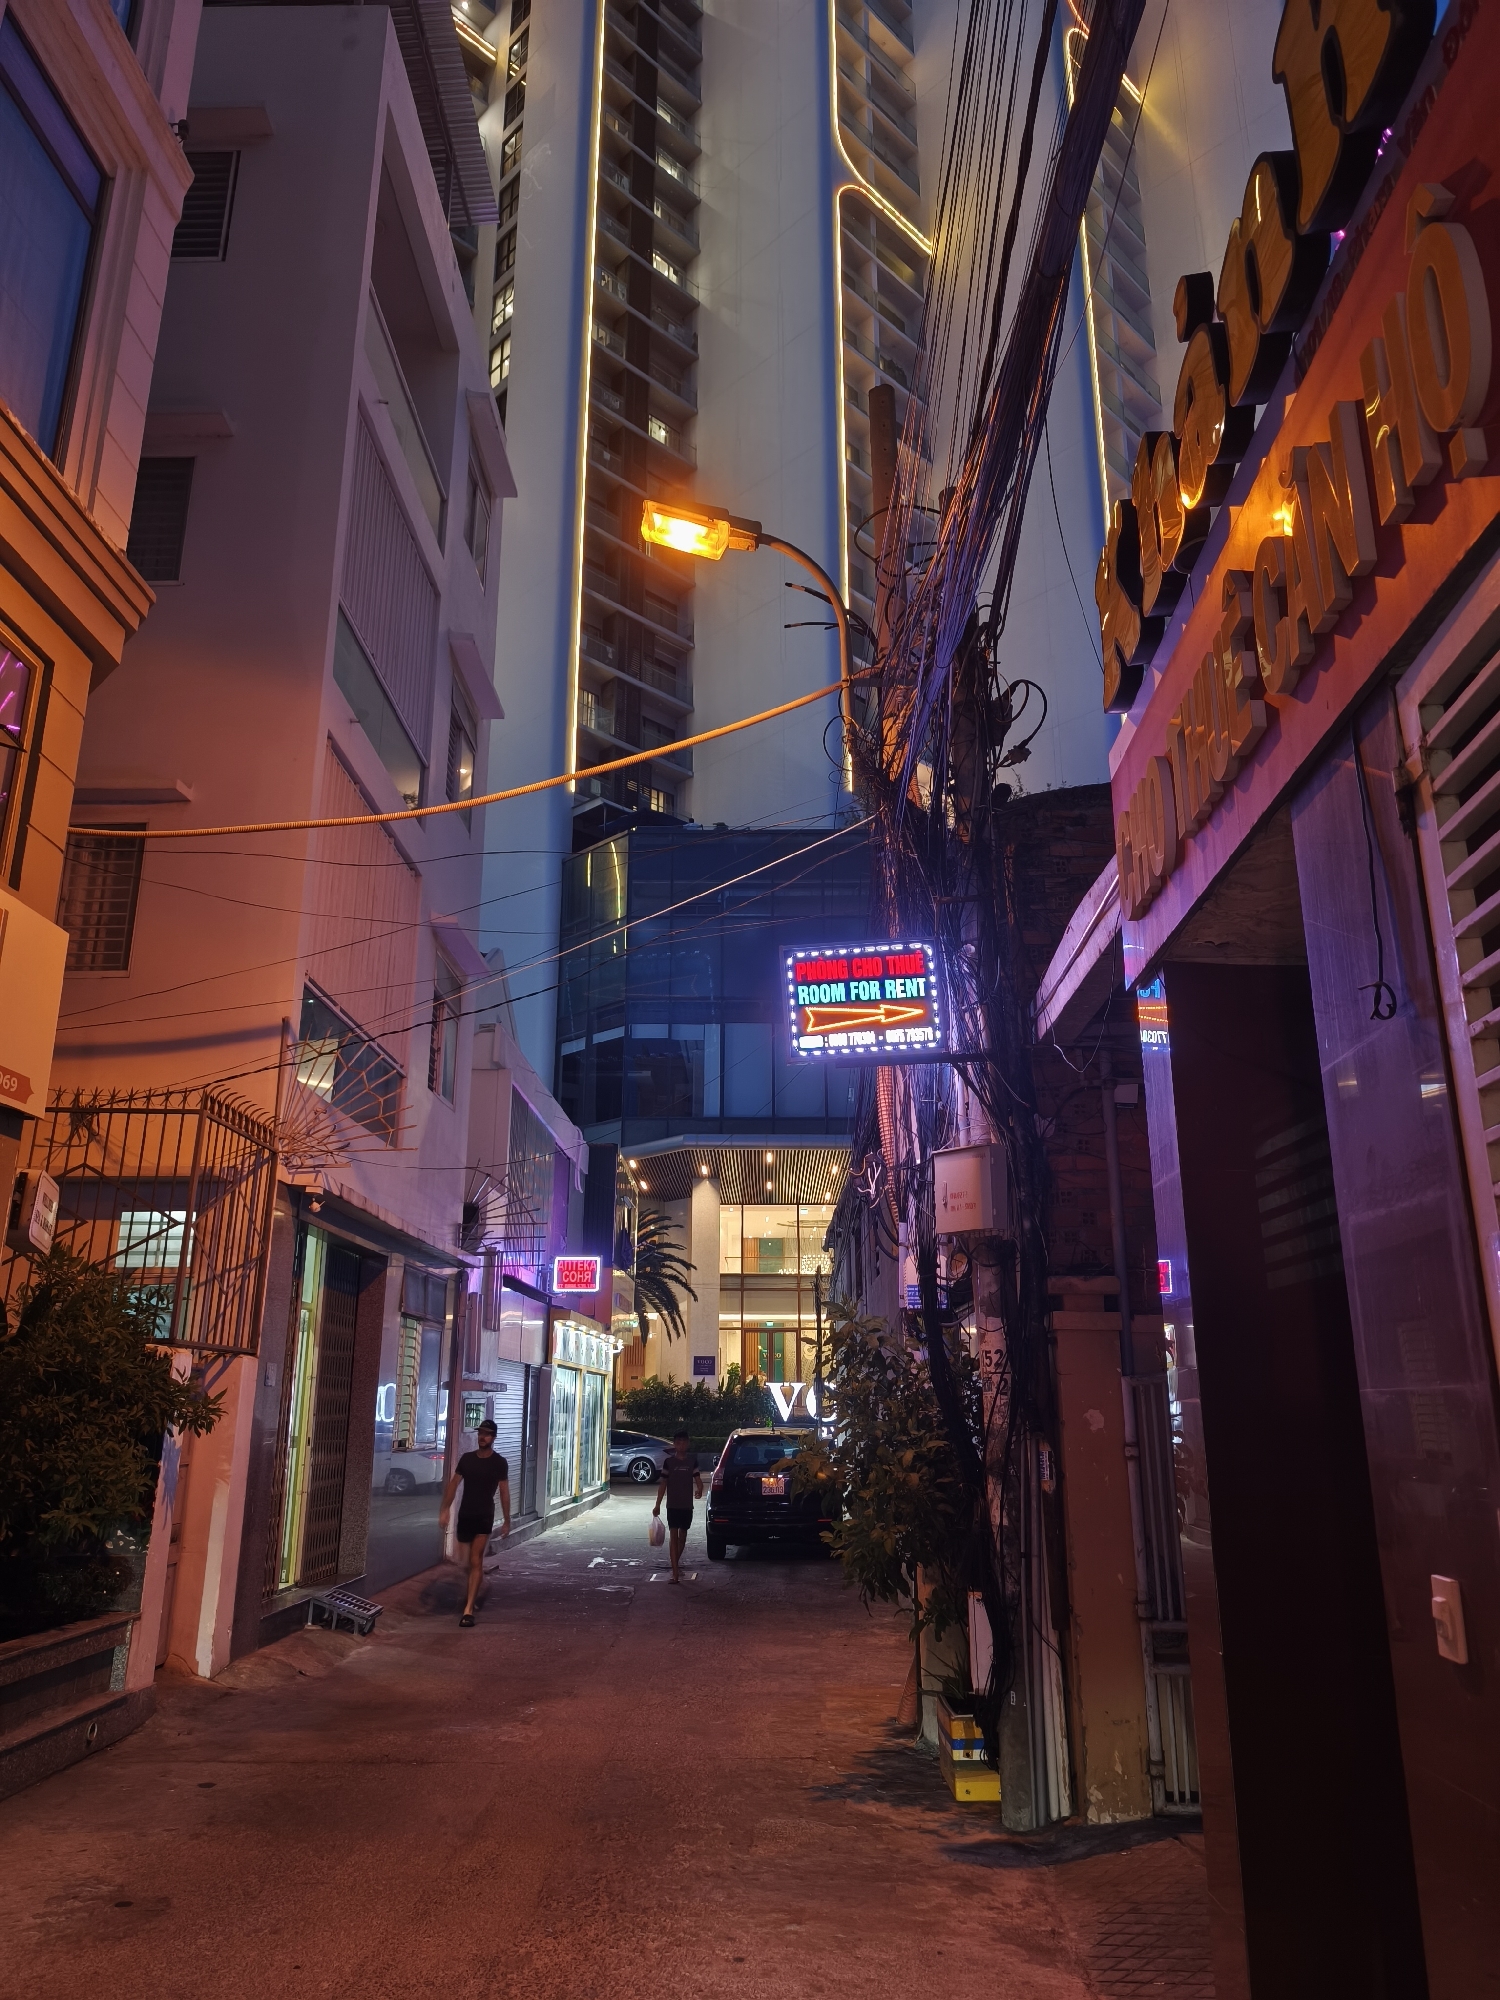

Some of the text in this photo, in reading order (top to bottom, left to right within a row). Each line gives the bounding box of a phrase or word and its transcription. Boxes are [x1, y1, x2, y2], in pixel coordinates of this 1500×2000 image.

[1116, 755, 1177, 921] CHO
[1166, 568, 1267, 841] THUÊ
[796, 950, 925, 981] PHÒNG CHO THUÊ
[798, 978, 926, 1004] ROOM FOR RENT
[557, 1260, 597, 1271] АПТЕКА
[562, 1271, 592, 1283] СОНЯ
